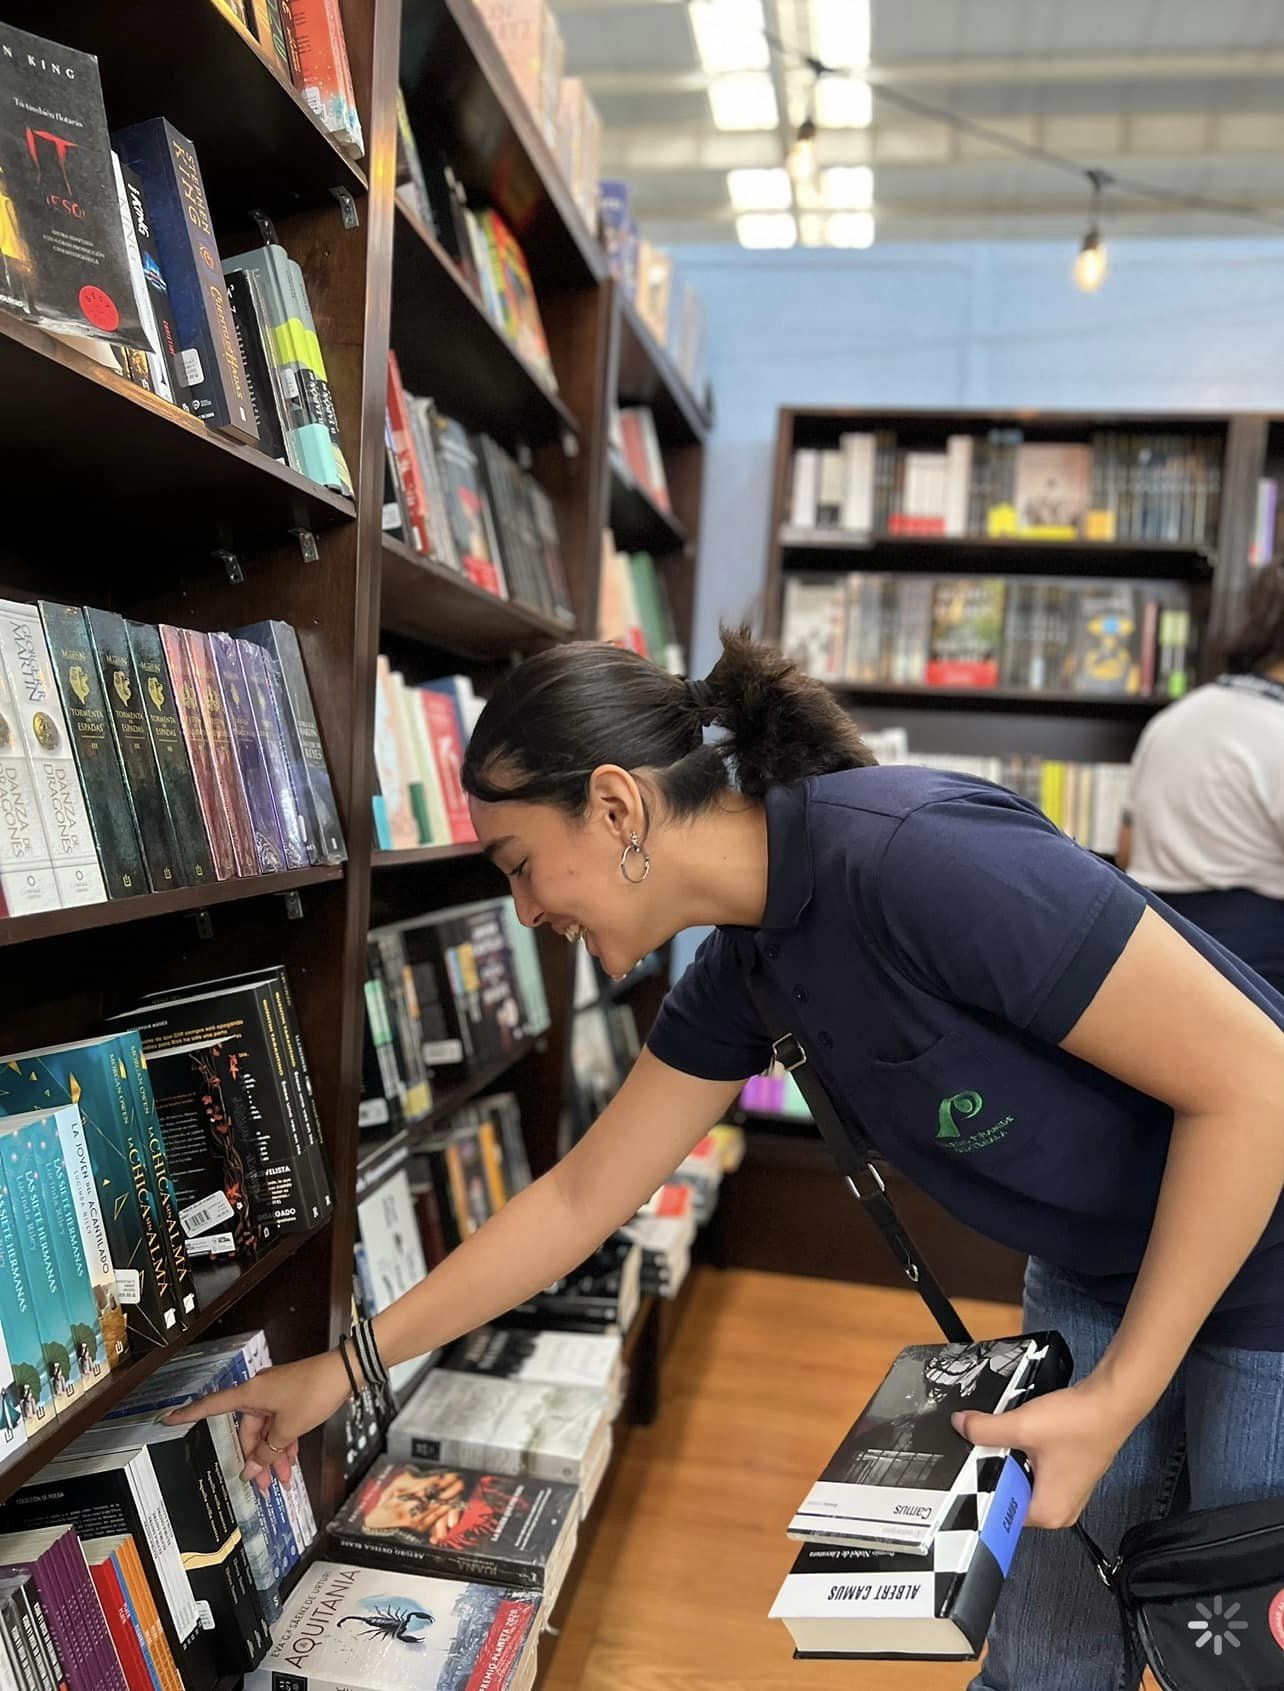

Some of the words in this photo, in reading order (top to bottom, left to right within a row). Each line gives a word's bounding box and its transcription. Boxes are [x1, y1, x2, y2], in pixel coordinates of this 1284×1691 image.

[27, 54, 75, 80] KING
[25, 127, 79, 197] IT
[172, 140, 202, 228] KING
[186, 152, 211, 235] STEPHEN
[210, 285, 230, 343] CUENTO
[226, 350, 244, 399] HADAS
[9, 620, 42, 701] MARTIN
[70, 707, 104, 719] TORMENTA
[77, 722, 104, 733] ESPADAS
[115, 710, 145, 720] TORMENTA
[121, 723, 145, 733] ESPADAS
[0, 763, 24, 858] AGONES
[5, 767, 29, 832] DANZA
[43, 763, 73, 855] DRAGONES
[55, 768, 77, 828] DANZA
[262, 999, 274, 1032] QUENTIN
[270, 1032, 284, 1076] TARANTINO
[283, 1025, 296, 1068] TARANTINO
[25, 1170, 36, 1192] LAS
[53, 1158, 64, 1181] LAS
[60, 1180, 71, 1209] SIETE
[71, 1122, 79, 1138] LA
[75, 1143, 89, 1180] JOVEN
[88, 1200, 110, 1274] ACANTILADO
[73, 1169, 86, 1208] LUCINDA
[0, 1208, 13, 1242] SIETE
[26, 1220, 38, 1251] Riley
[31, 1192, 43, 1223] SIETE
[55, 1204, 66, 1236] Riley
[128, 1149, 152, 1220] CHICA
[146, 1231, 169, 1296] ALMA
[149, 1137, 172, 1204] CHICA
[166, 1215, 189, 1281] ALMA
[35, 1223, 58, 1294] HERMANAS
[64, 1209, 84, 1278] HERMANAS
[6, 1244, 27, 1313] HERMANAS
[893, 1503, 933, 1520] Camus
[1002, 1497, 1019, 1534] CAMUS
[285, 1570, 360, 1669] AQUITANIA
[827, 1584, 873, 1601] CAMUS
[874, 1584, 921, 1600] ALBERT
[271, 1641, 284, 1657] EVA
[307, 1595, 317, 1605] DE
[478, 1662, 498, 1691] PREMIO
[491, 1626, 517, 1662] PLANETA
[505, 1609, 521, 1627] 2020
